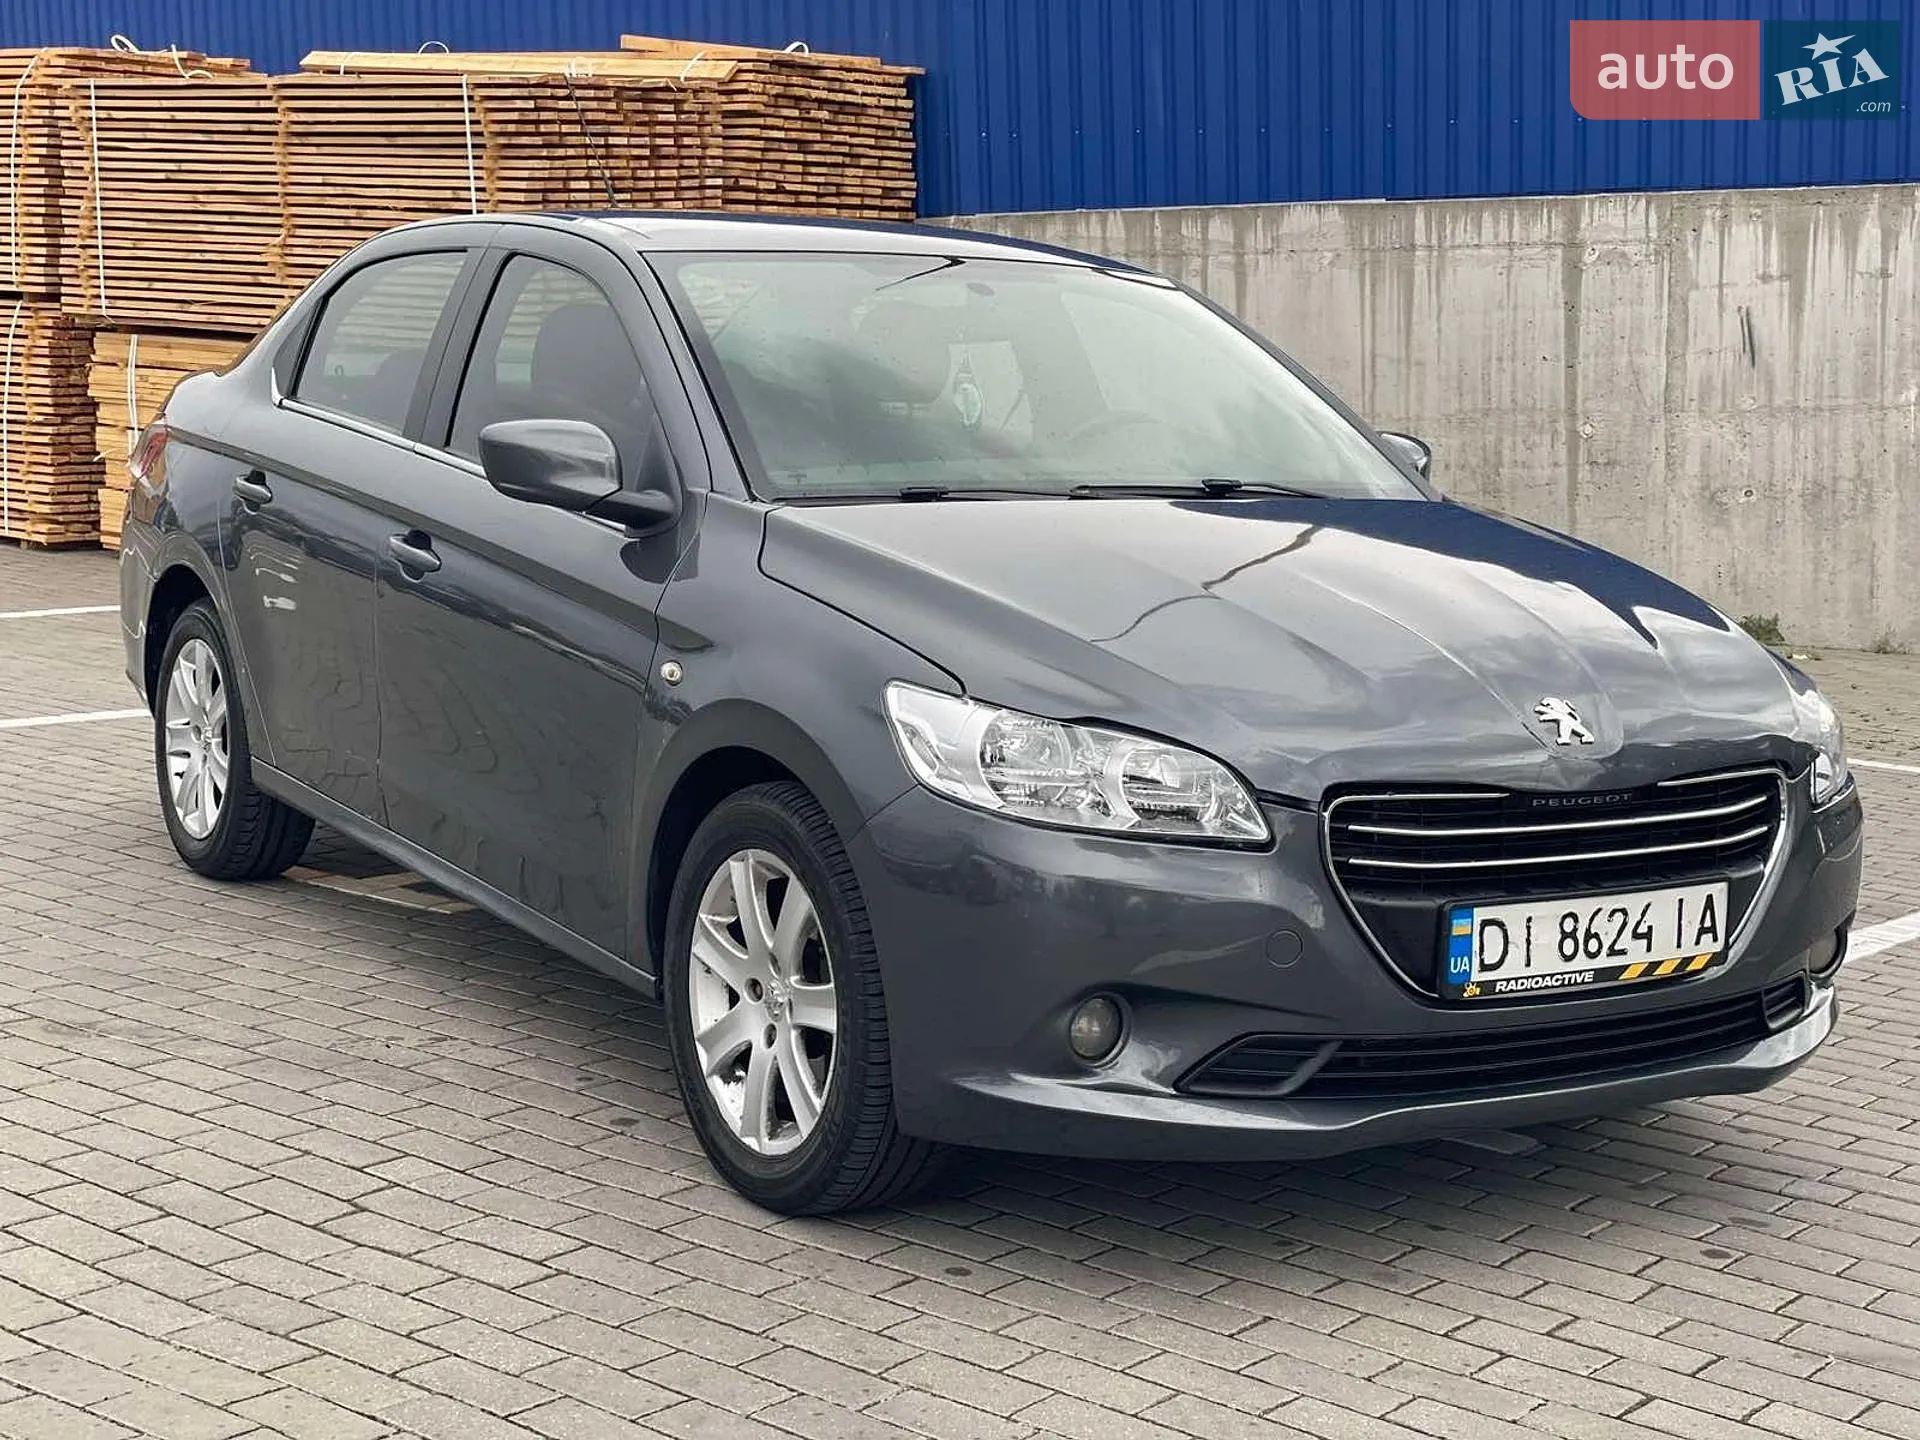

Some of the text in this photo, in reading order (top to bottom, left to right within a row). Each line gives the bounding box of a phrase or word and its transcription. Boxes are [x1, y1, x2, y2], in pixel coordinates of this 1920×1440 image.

[1532, 793, 1632, 807] PEUGEOT
[1478, 894, 1719, 973] DI 8624 IA
[1450, 956, 1470, 974] UA
[1495, 971, 1594, 993] RADIOACTIVE
